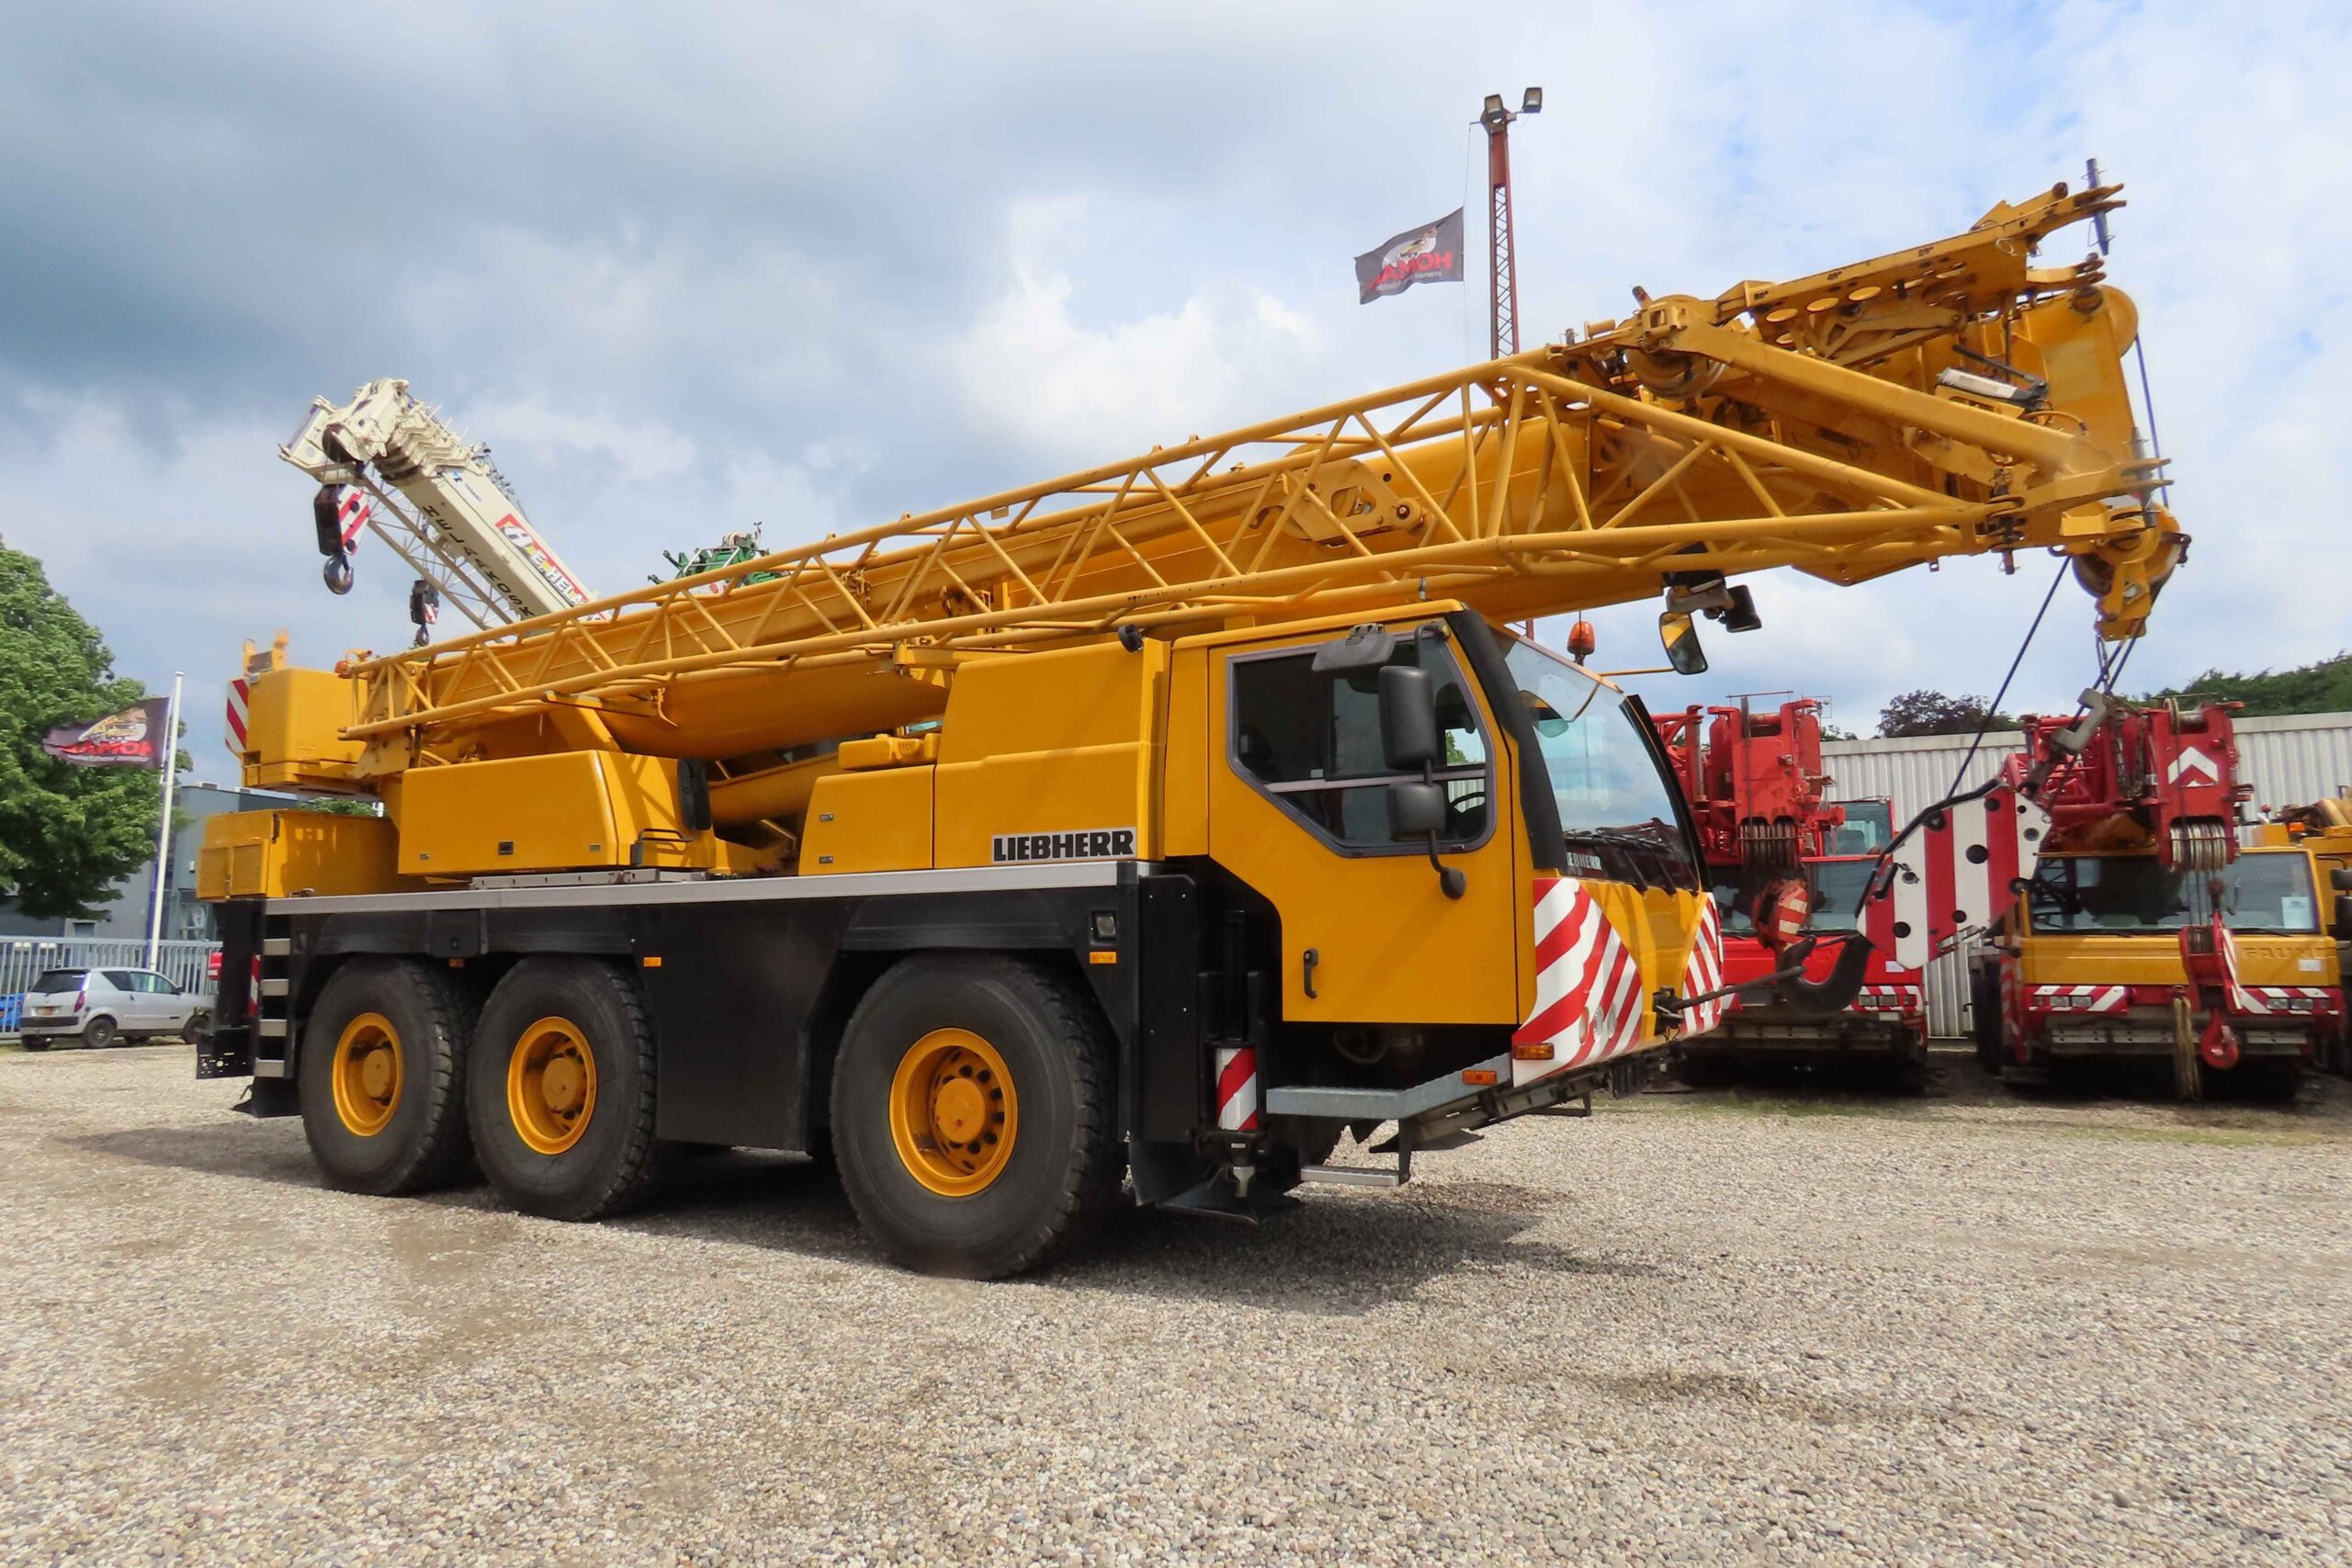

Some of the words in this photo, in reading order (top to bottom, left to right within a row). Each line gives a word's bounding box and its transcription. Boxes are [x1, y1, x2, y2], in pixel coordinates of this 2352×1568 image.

[423, 504, 535, 617] HELAAKOSK
[993, 829, 1134, 862] LIEBHERR
[1566, 852, 1602, 871] IEBHERR
